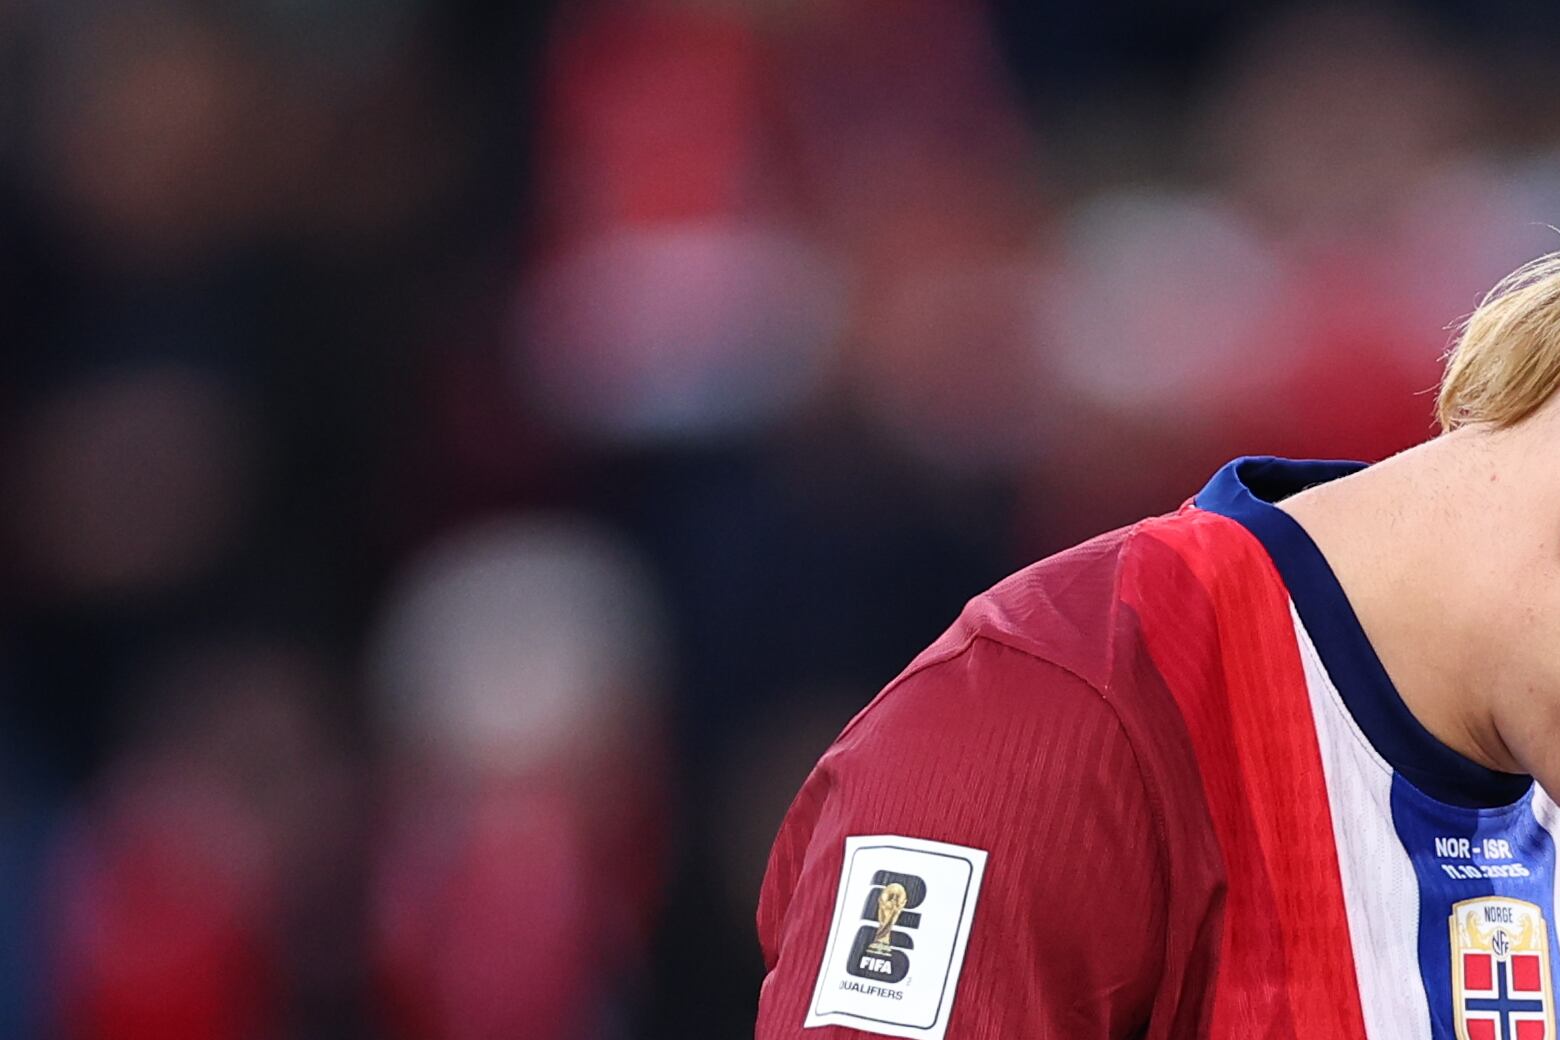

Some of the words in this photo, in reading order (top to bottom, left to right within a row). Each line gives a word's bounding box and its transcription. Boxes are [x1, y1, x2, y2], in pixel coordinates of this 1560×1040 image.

[1435, 837, 1471, 859] NOR
[1483, 838, 1513, 859] ISR
[1441, 863, 1530, 879] 11.10.2025
[1484, 906, 1514, 923] NORGE
[860, 956, 892, 974] FIFA
